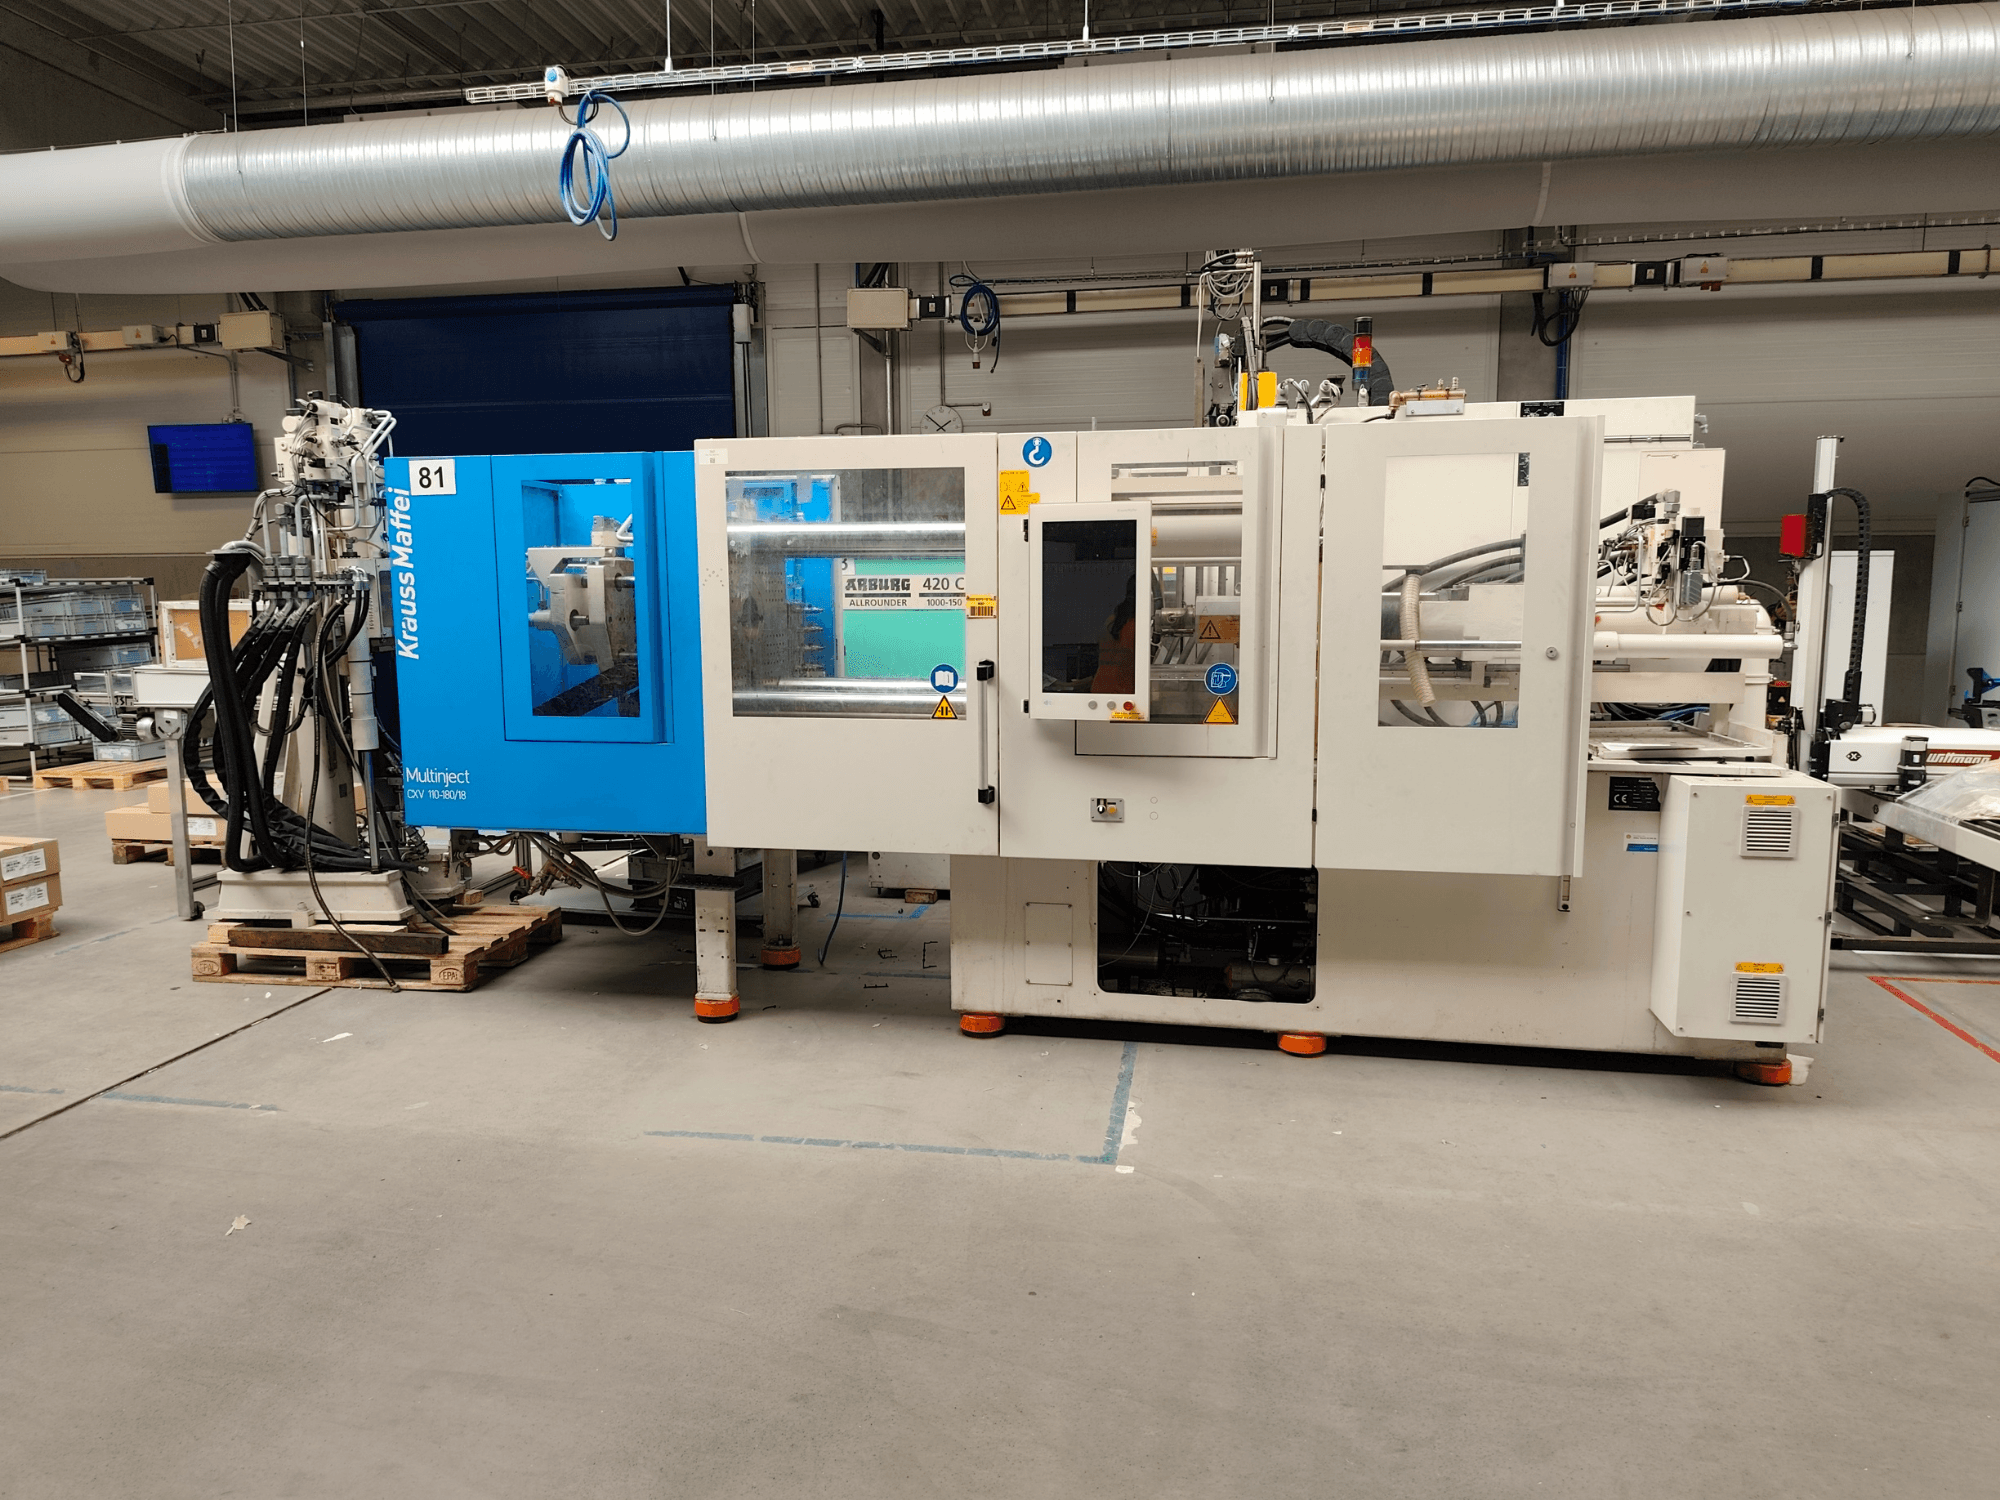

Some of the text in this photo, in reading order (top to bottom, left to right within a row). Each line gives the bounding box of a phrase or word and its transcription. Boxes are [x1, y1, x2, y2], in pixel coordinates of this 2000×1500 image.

[418, 466, 444, 489] 81
[845, 577, 965, 591] ARBURG 420 C
[849, 599, 907, 607] ALLROUNDER
[926, 598, 963, 607] 1000-150
[405, 767, 470, 788] Multinject
[407, 789, 425, 799] CXV
